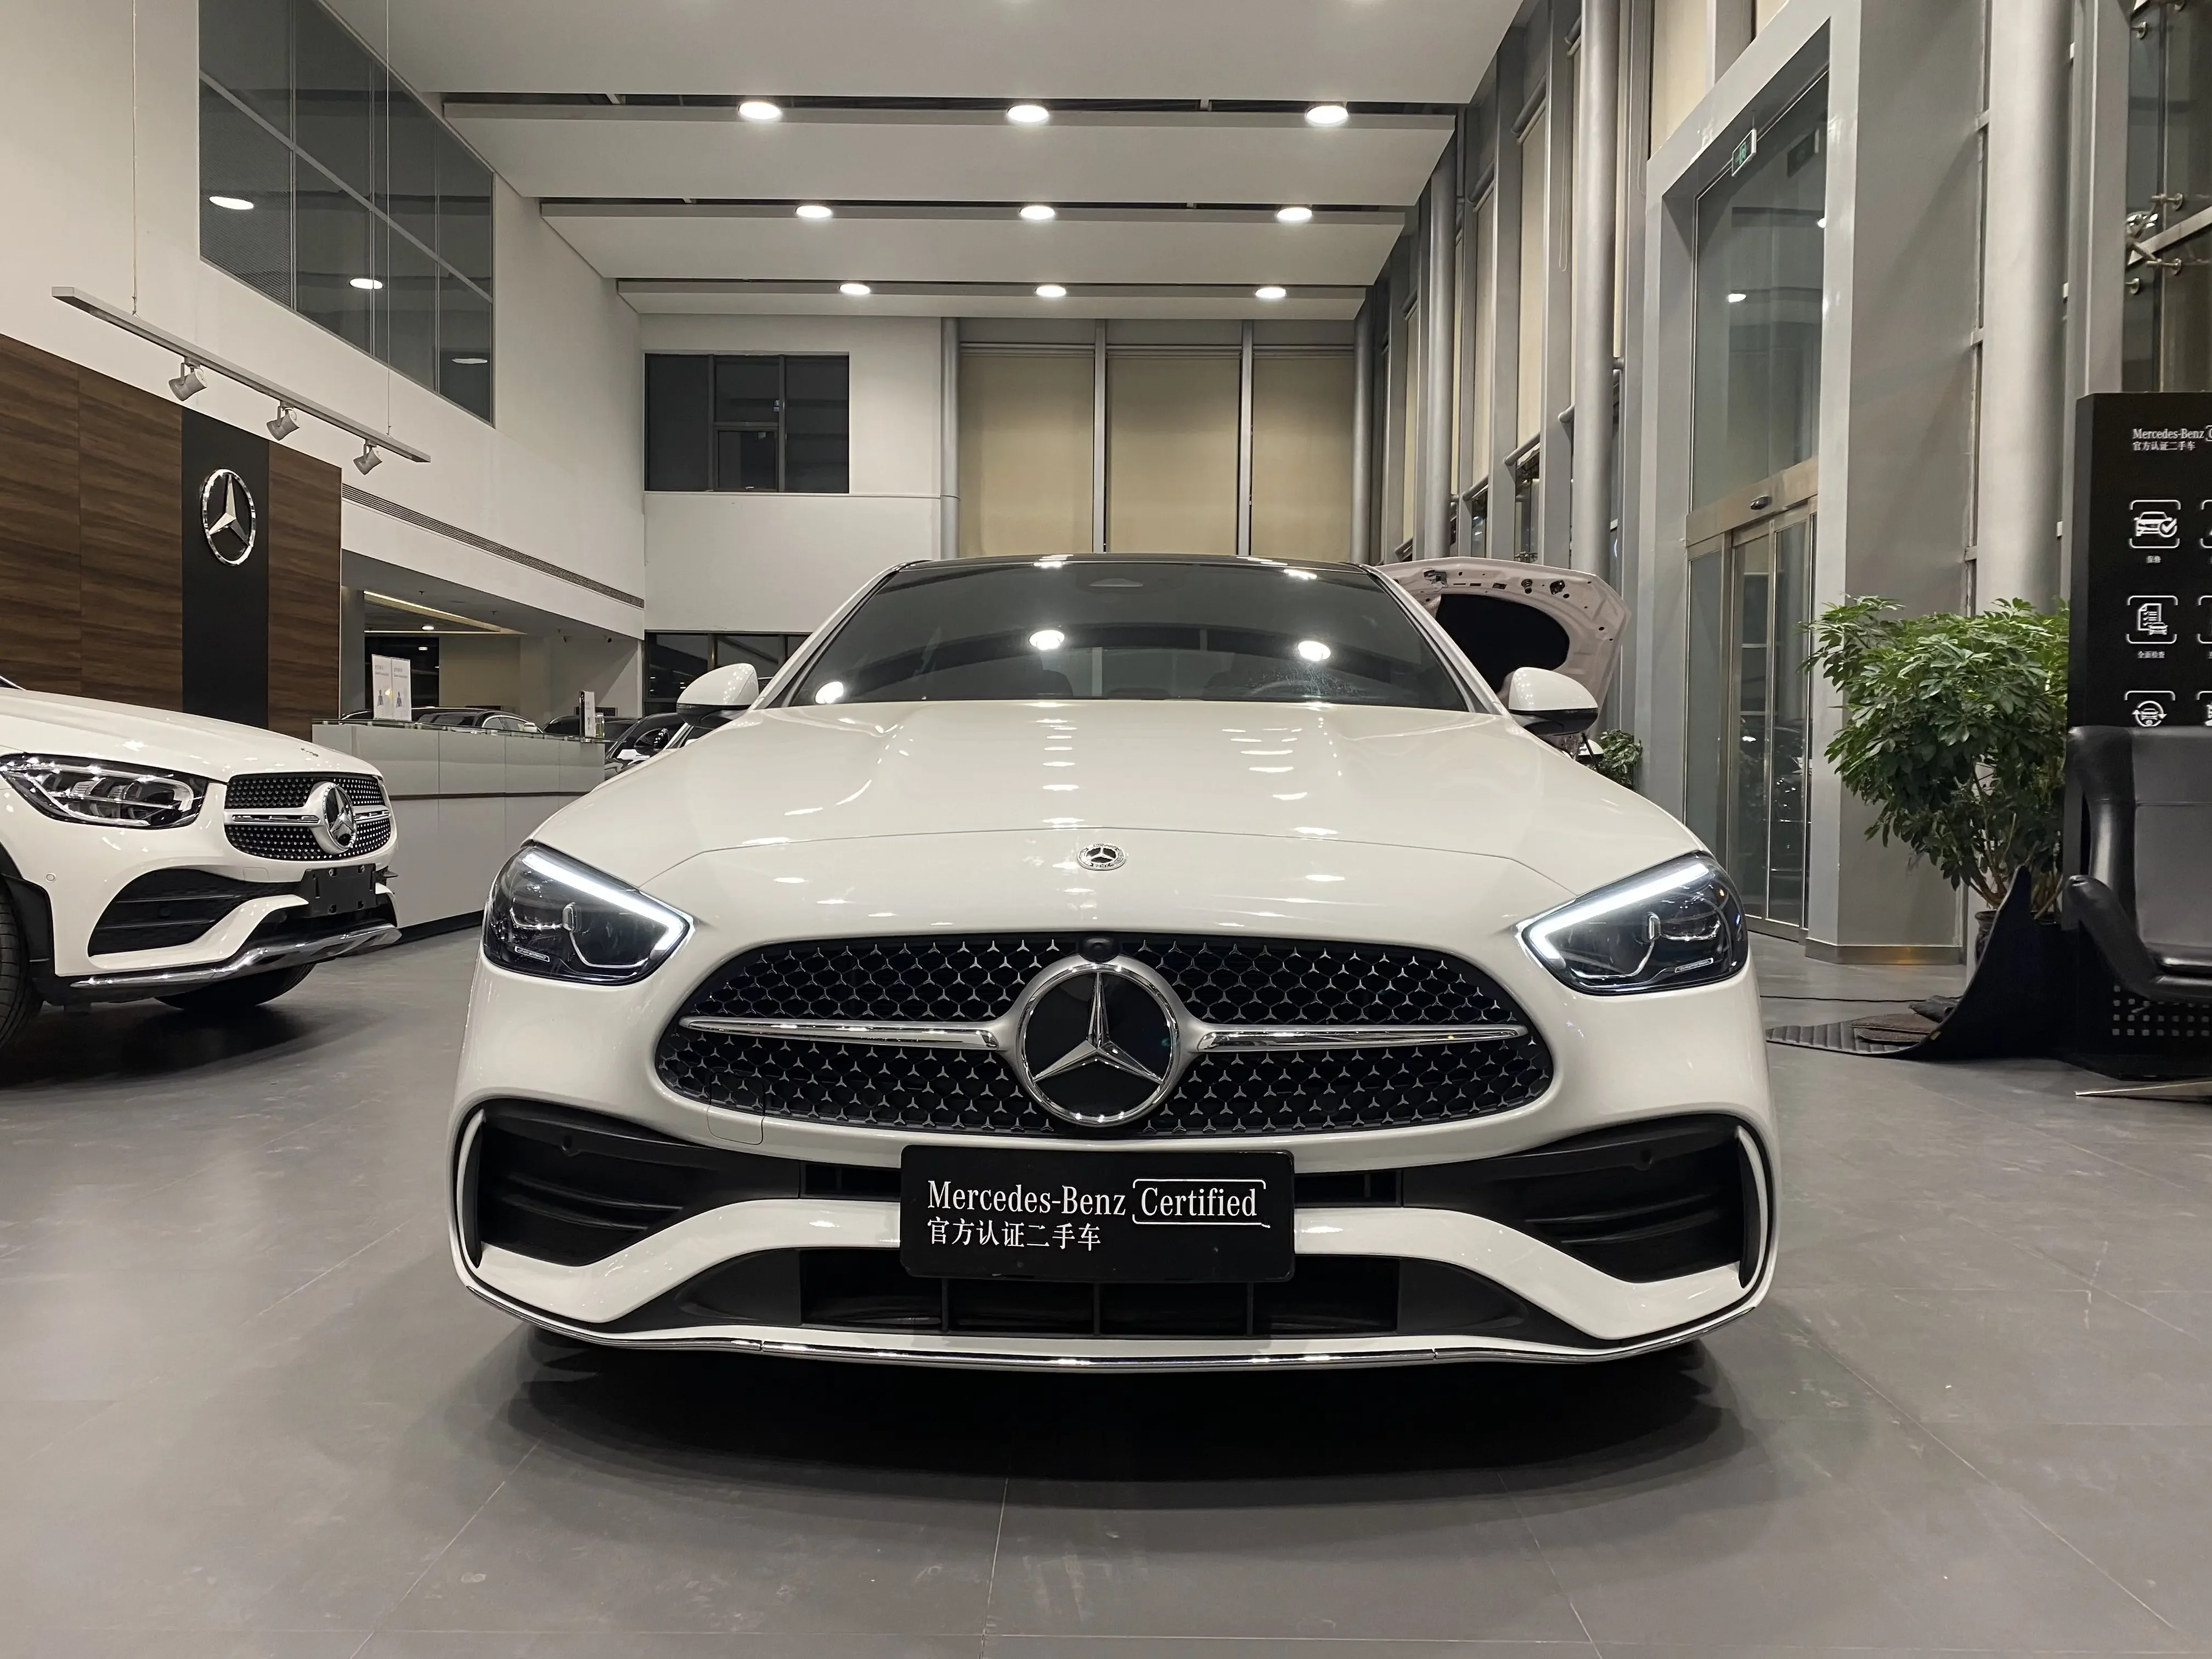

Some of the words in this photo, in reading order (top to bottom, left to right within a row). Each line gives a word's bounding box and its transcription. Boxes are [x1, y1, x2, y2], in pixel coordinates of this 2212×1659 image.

[2132, 428, 2204, 439] Mercedes-Benz
[2133, 441, 2196, 451] 官方认证二手车
[927, 1180, 1126, 1216] Mercedes-Benz
[1141, 1187, 1258, 1217] Certified
[927, 1216, 1102, 1252] 官方认证二手车
